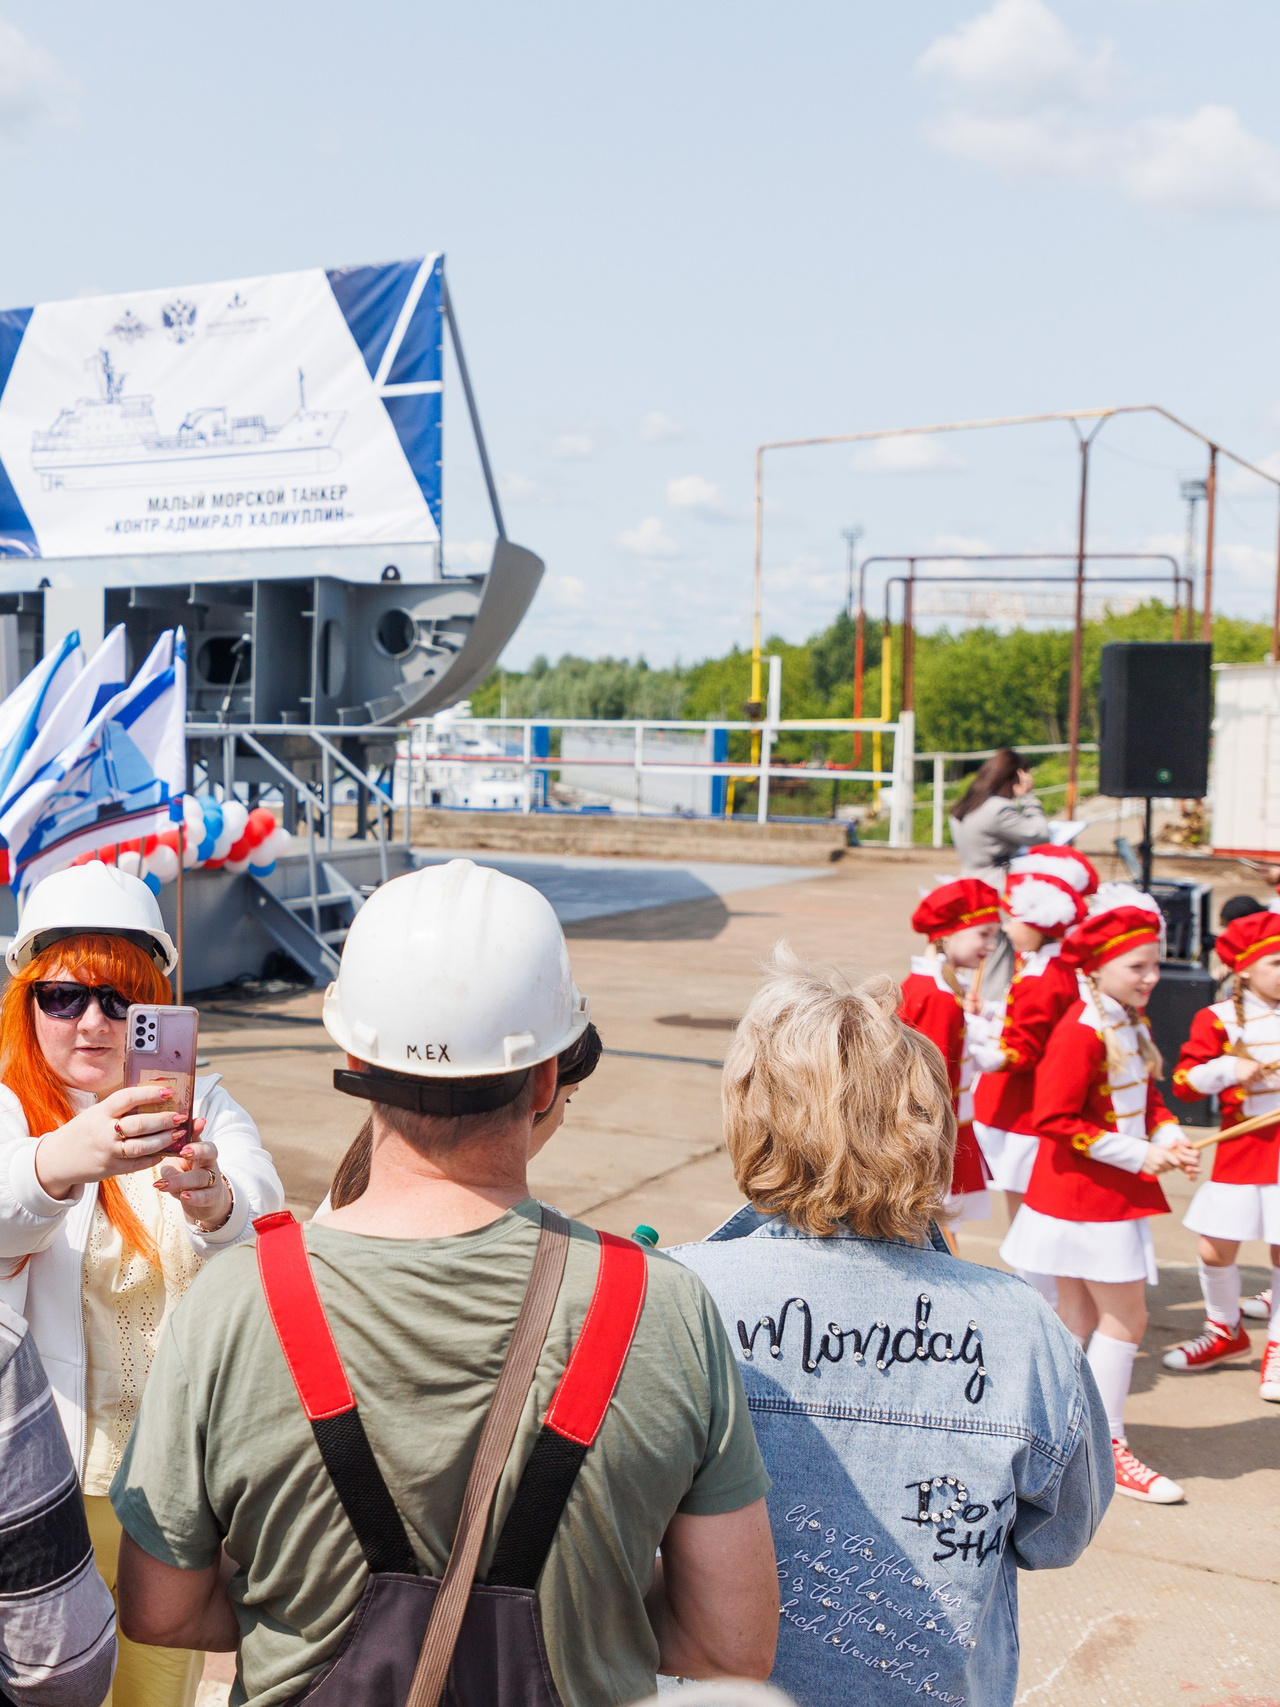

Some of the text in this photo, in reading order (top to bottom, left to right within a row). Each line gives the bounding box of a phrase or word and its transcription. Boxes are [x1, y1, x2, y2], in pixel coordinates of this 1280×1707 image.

[147, 485, 348, 512] МАЛЫЙ МОРСКОЙ ТАНКЕР
[737, 1293, 988, 1404] Monday
